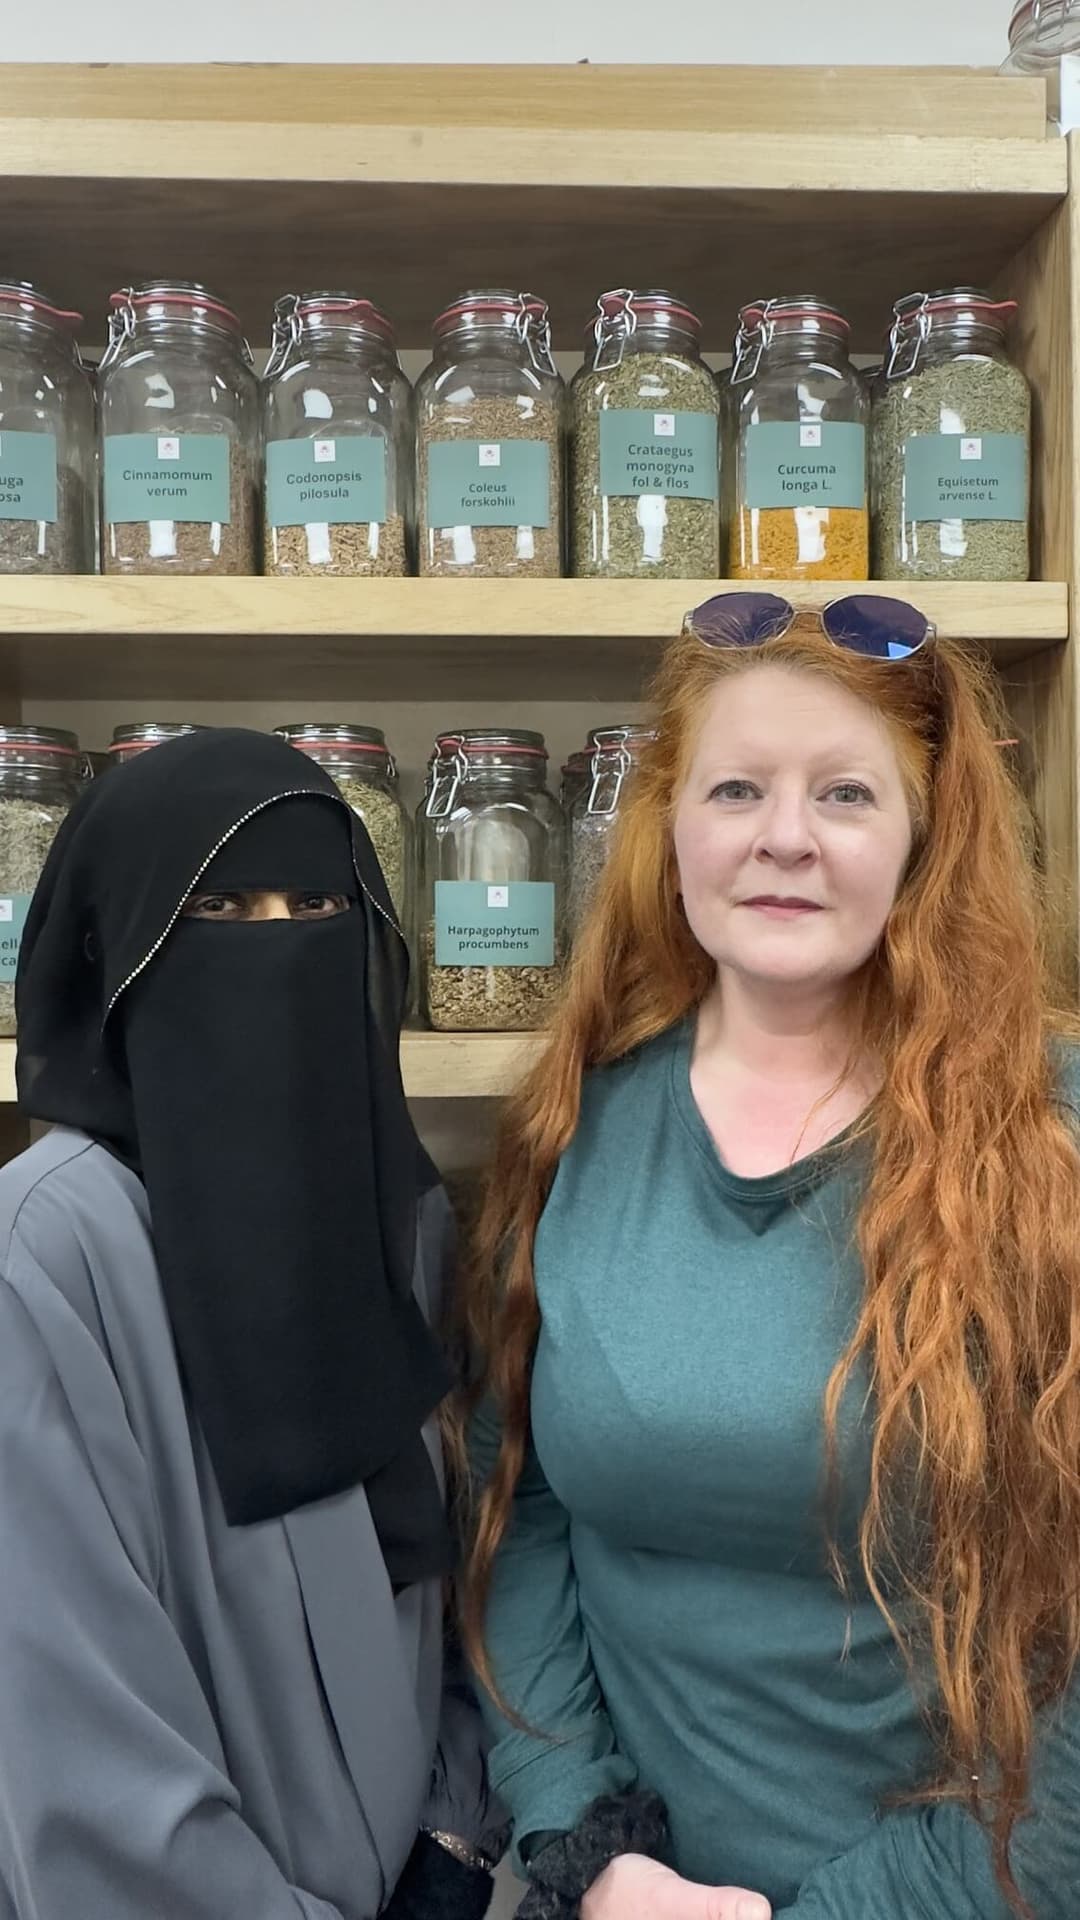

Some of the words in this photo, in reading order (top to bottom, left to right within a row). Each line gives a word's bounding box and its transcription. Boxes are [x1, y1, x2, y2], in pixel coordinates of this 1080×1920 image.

[627, 443, 693, 459] Crataegus
[122, 469, 213, 482] Cinnamomum
[626, 462, 695, 476] monogyna
[777, 463, 837, 476] Curcuma
[286, 470, 363, 485] Codonopsis
[631, 475, 649, 488] fol
[652, 476, 663, 488] &
[665, 476, 689, 490] flos
[937, 476, 999, 489] Equisetum
[146, 487, 188, 497] verum
[468, 482, 507, 494] Coleus
[781, 479, 818, 493] longa
[821, 479, 833, 491] L.
[299, 487, 350, 502] pilosula
[938, 491, 985, 502] arvense
[460, 495, 516, 508] forskohlii
[447, 925, 540, 938] Harpagophytum
[458, 939, 530, 952] procumbens
